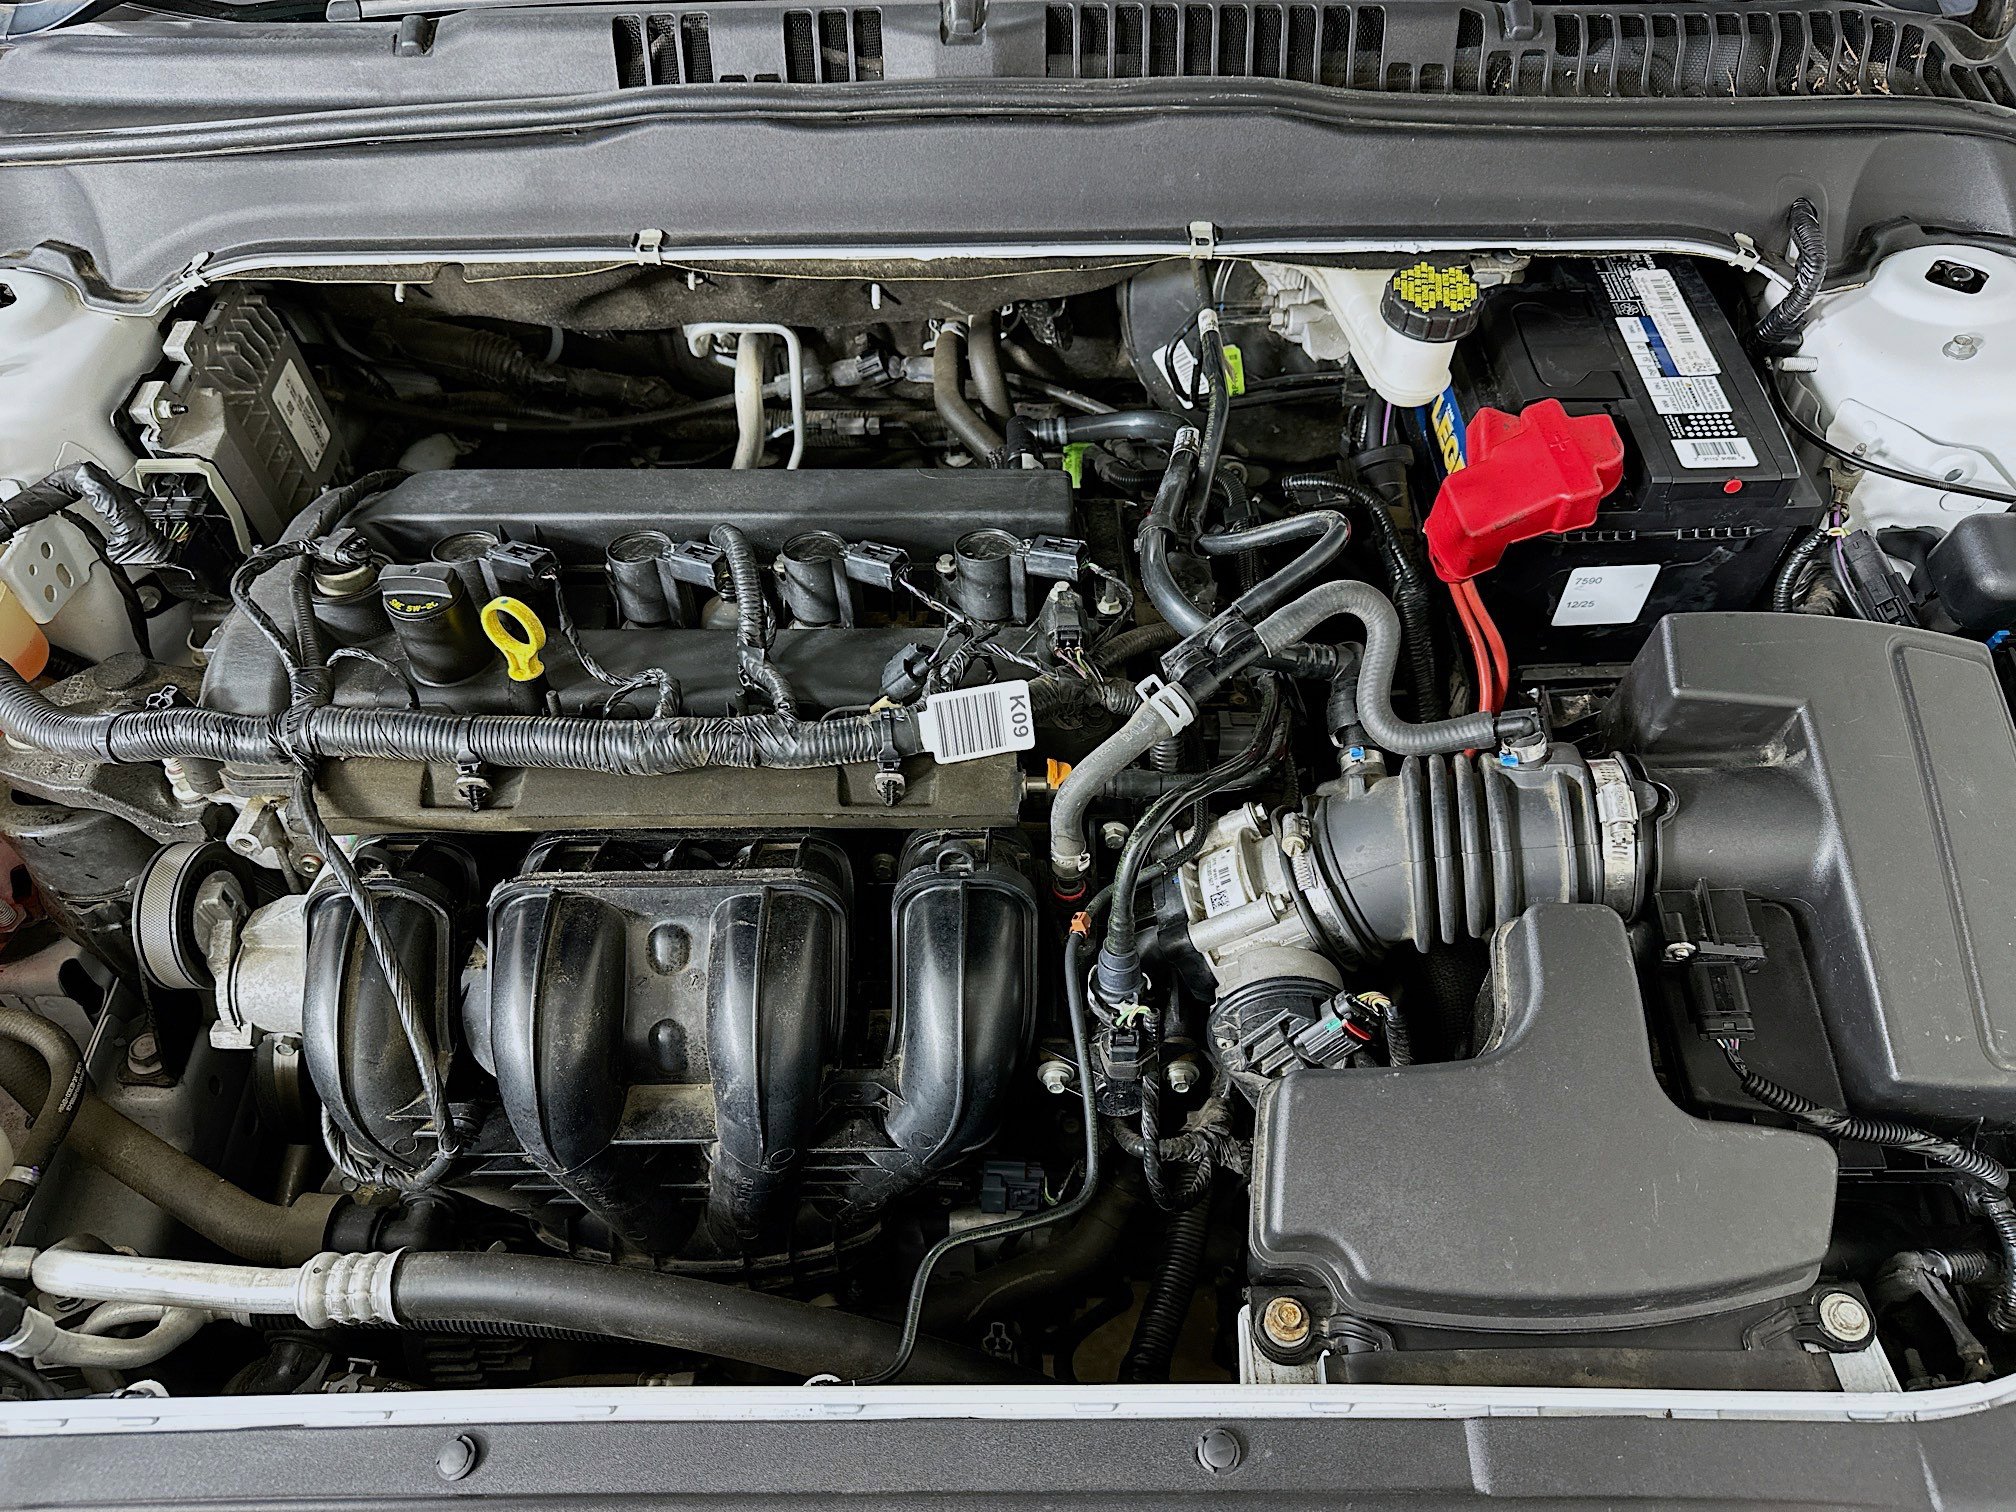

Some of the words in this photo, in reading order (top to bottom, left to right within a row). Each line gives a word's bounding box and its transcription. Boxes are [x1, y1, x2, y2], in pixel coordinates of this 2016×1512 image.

[1575, 576, 1603, 585] 7590
[387, 598, 405, 611] SAE
[1566, 600, 1595, 609] 12/25
[1009, 695, 1029, 738] K09
